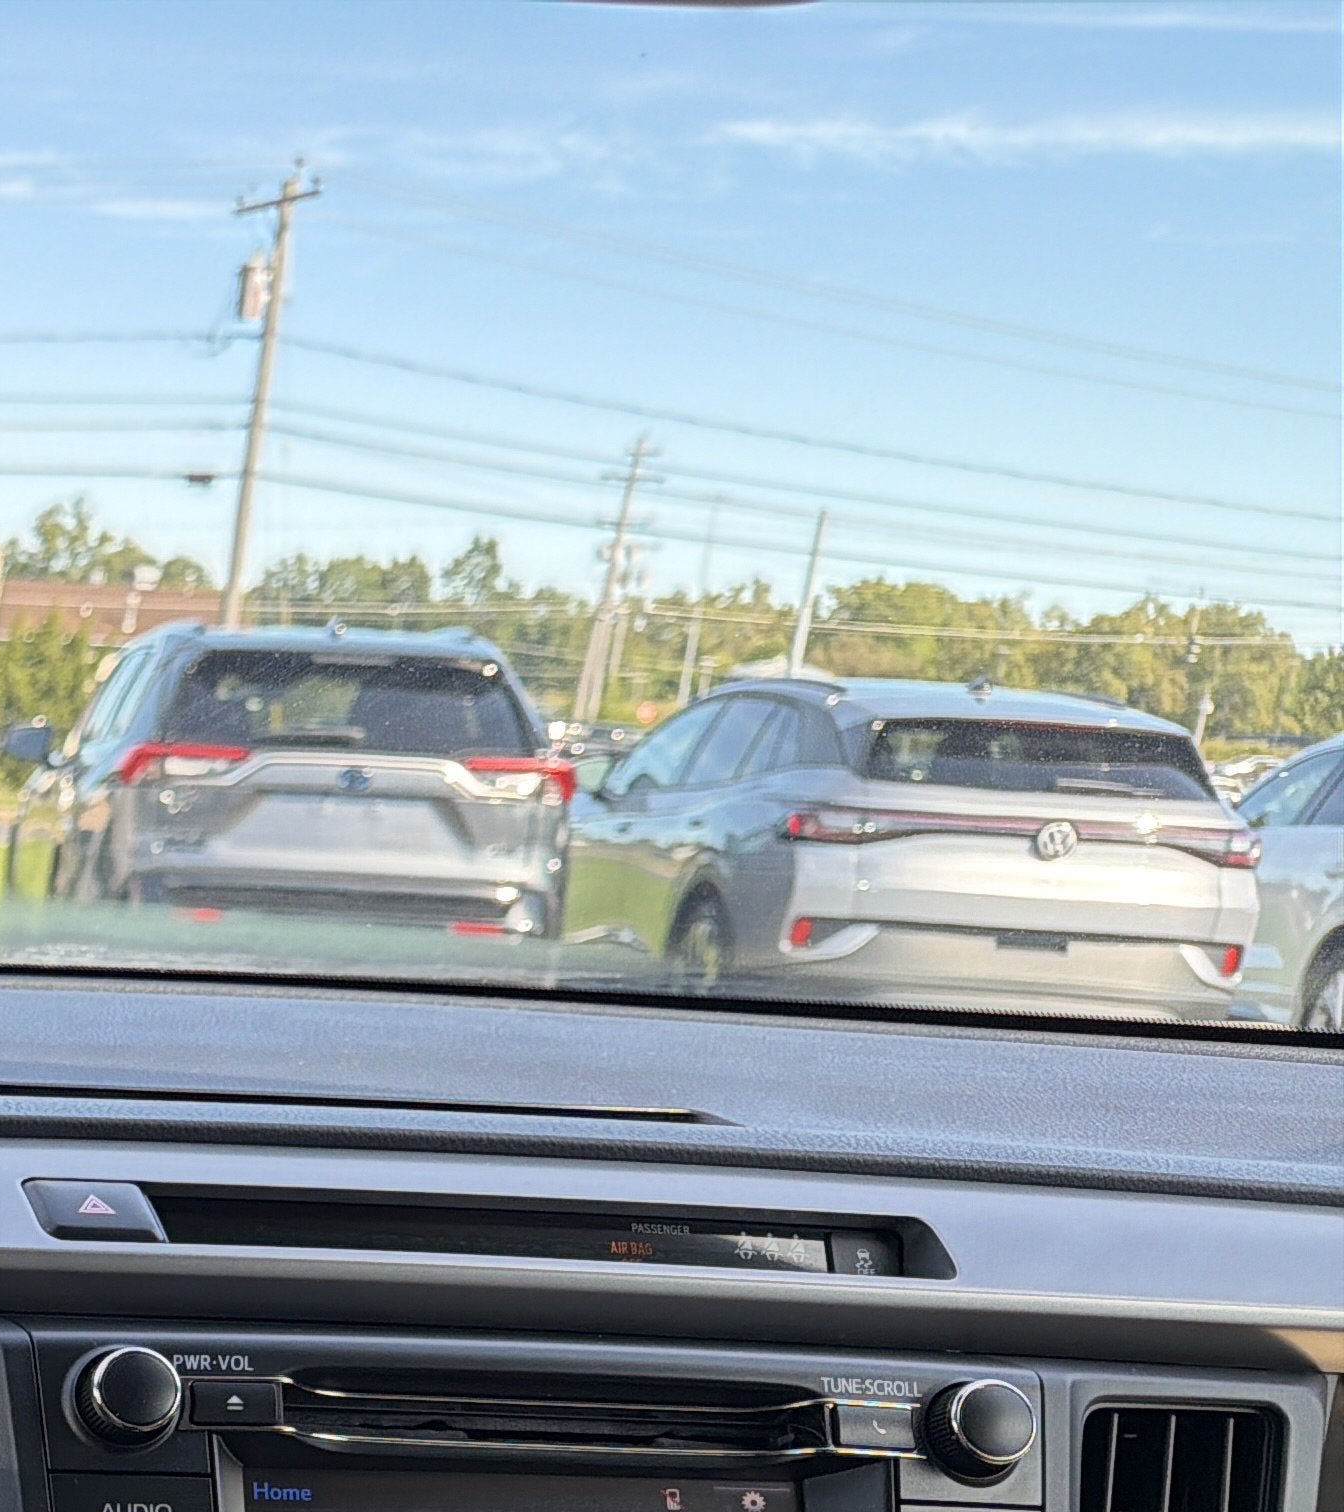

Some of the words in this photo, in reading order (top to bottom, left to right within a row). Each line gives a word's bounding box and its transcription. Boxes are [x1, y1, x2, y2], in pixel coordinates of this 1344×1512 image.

[630, 1222, 691, 1236] PASSENGER
[610, 1240, 629, 1255] AIR
[630, 1241, 653, 1255] BAG
[252, 1482, 312, 1501] Home
